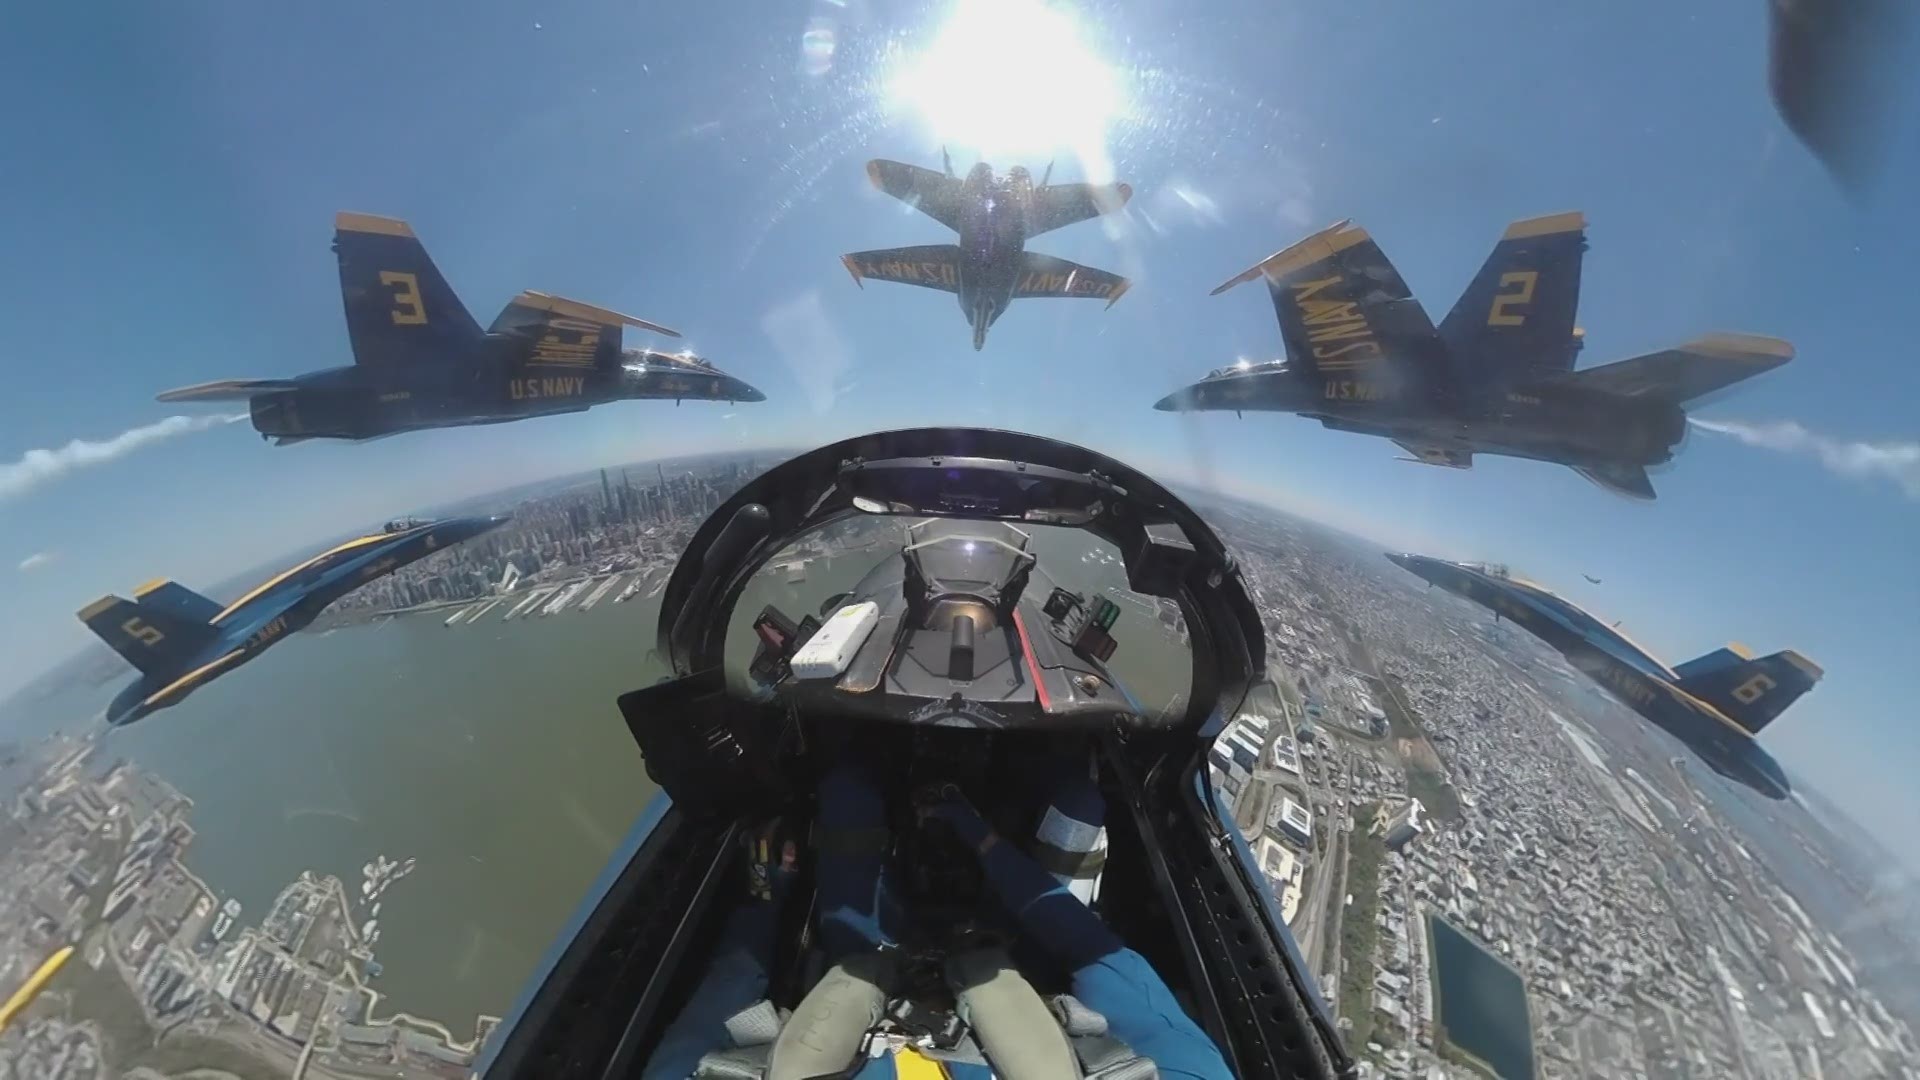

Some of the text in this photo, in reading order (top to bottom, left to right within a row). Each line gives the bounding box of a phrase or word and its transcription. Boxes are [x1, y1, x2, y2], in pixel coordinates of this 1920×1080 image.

[380, 270, 427, 324] 3
[1488, 271, 1538, 325] 2
[542, 377, 585, 397] NAVY
[121, 617, 164, 645] 5
[1731, 673, 1777, 704] 6
